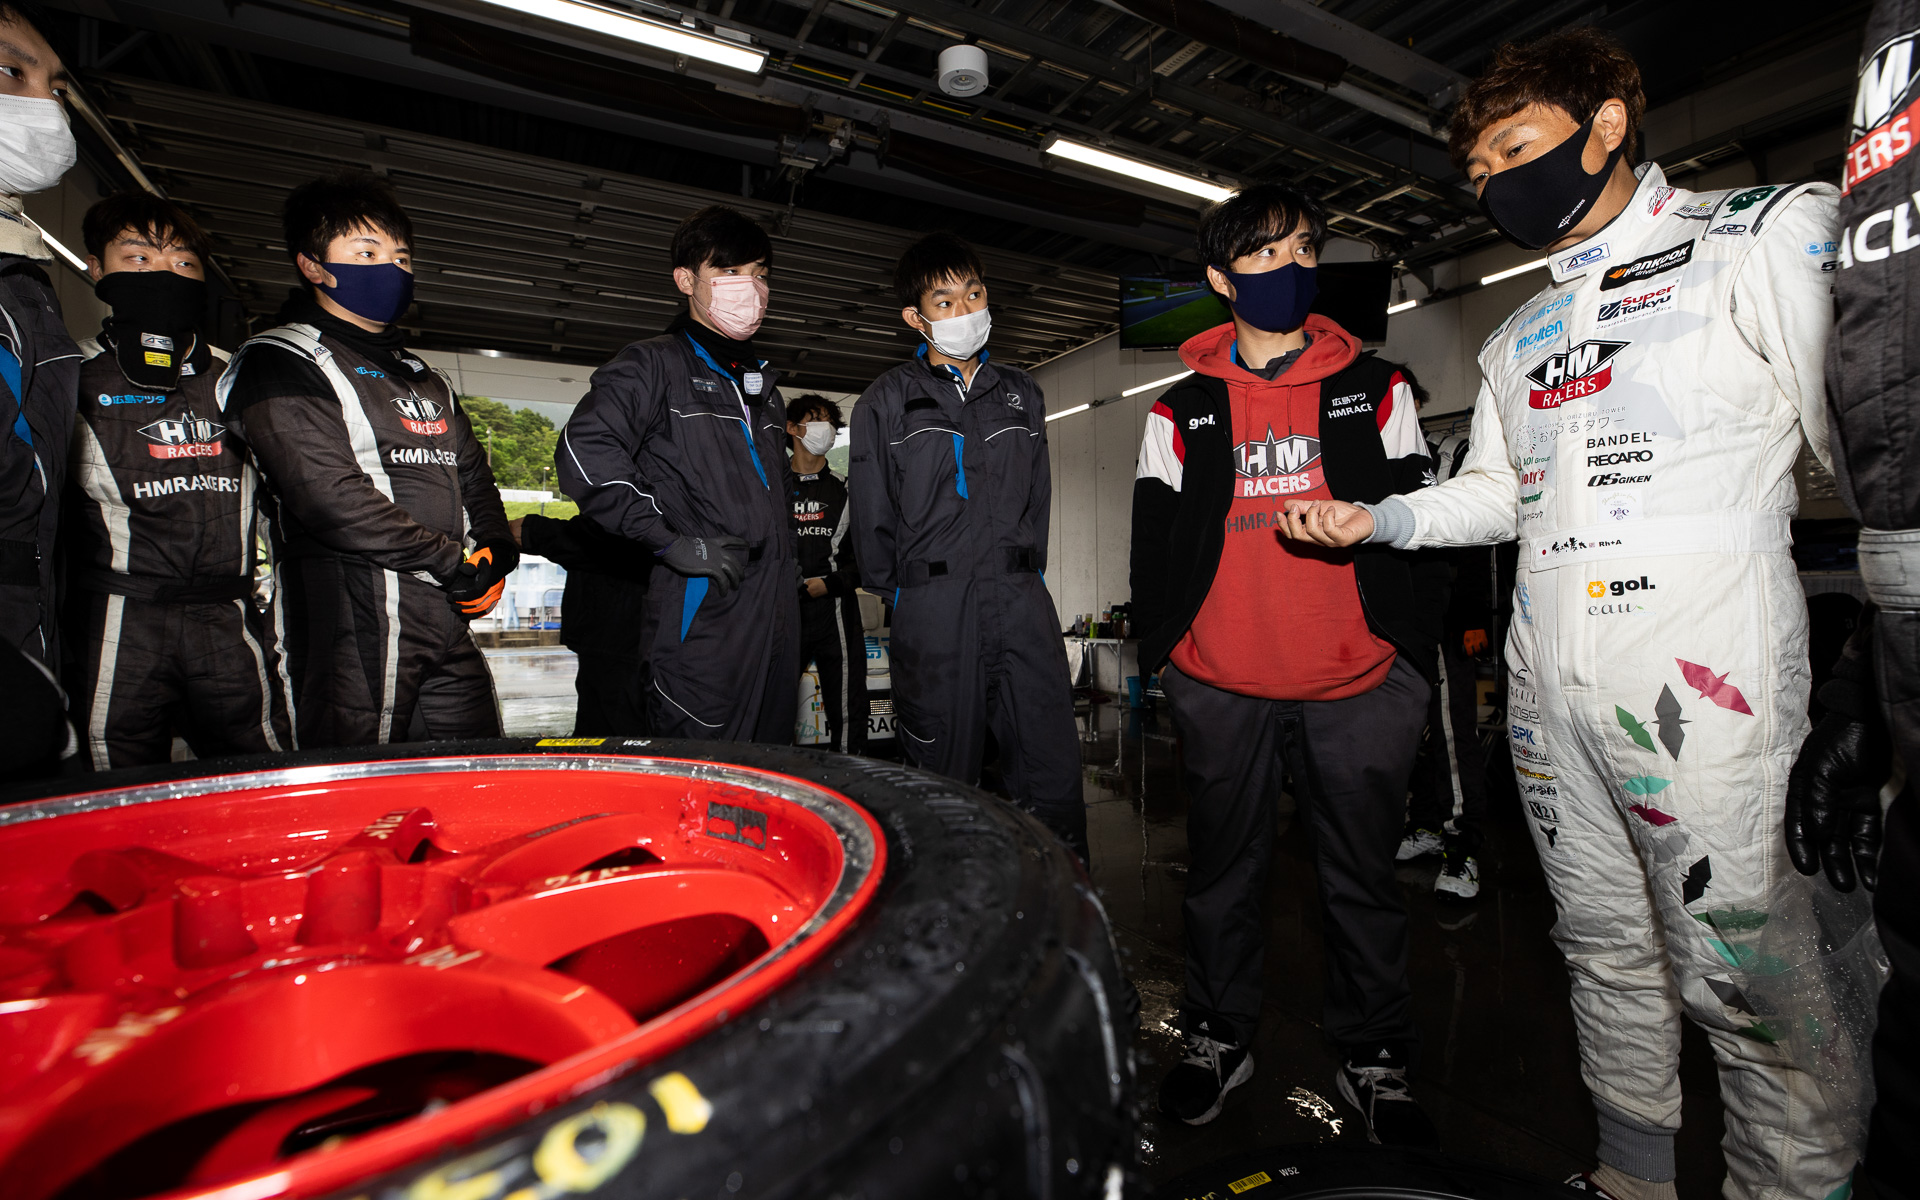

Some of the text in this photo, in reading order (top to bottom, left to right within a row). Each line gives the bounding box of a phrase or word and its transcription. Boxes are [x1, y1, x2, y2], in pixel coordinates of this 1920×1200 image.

[1843, 116, 1911, 193] ERS
[1567, 247, 1603, 268] ARD
[1635, 256, 1686, 277] driving emotion
[1621, 295, 1672, 316] Taikyu
[1622, 284, 1676, 306] Super
[1516, 319, 1564, 353] molten
[1544, 343, 1601, 387] HM
[112, 394, 167, 404] 広島マツダ
[1189, 414, 1216, 430] gol.
[1241, 438, 1309, 475] HM
[1587, 450, 1654, 468] RECARO
[1243, 473, 1311, 497] RACERS
[1610, 576, 1656, 597] gol.
[1588, 603, 1637, 616] eau
[1512, 725, 1537, 745] SPK
[1279, 1166, 1300, 1177] W52
